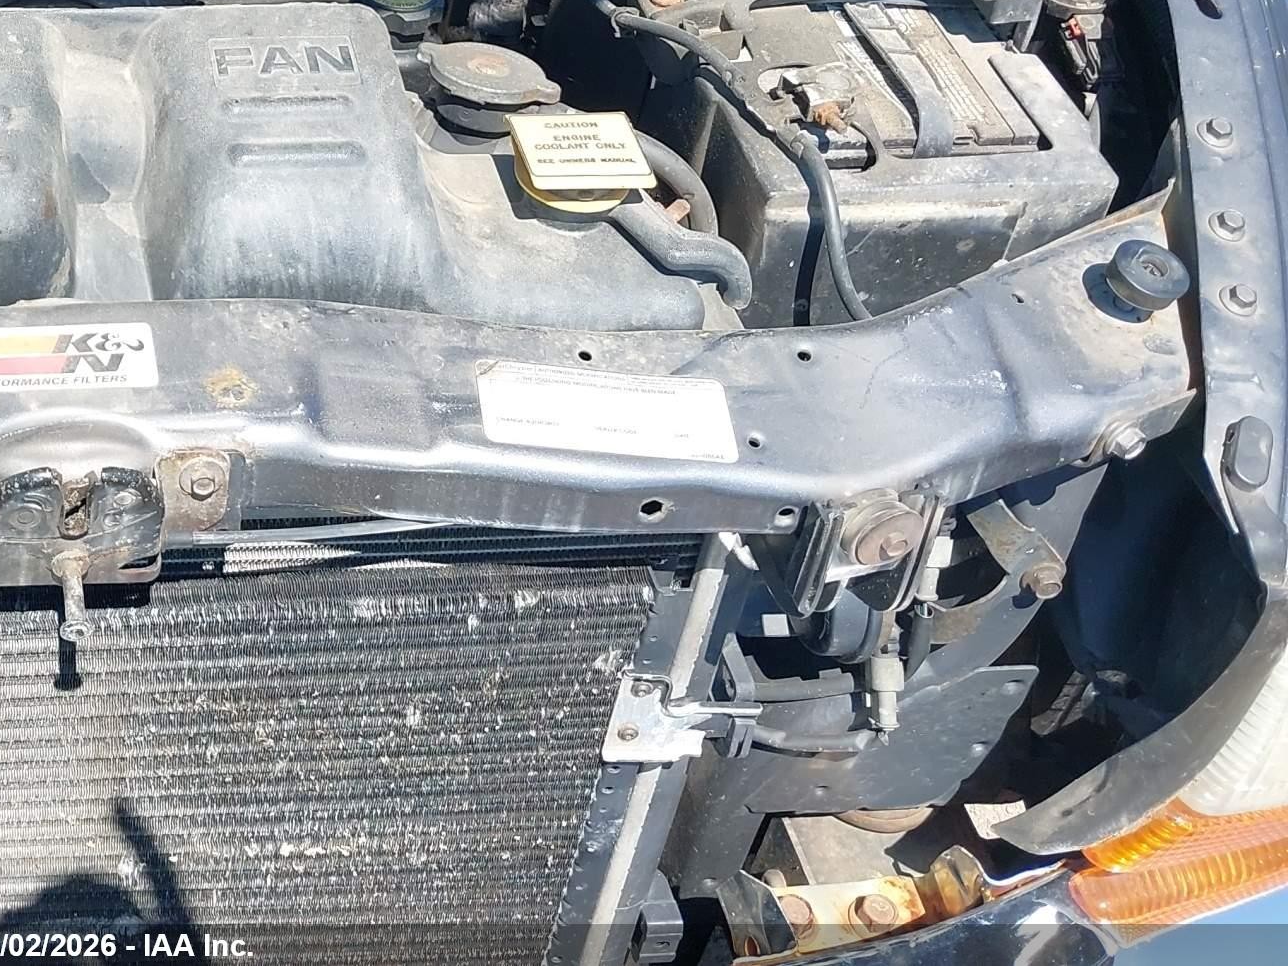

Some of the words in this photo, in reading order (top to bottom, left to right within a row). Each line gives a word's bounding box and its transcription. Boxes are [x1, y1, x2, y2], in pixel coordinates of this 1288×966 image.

[213, 45, 355, 76] FAN
[544, 121, 599, 129] CAUTION
[553, 134, 601, 142] ENGINE
[534, 143, 590, 151] COOLANT
[595, 142, 627, 150] ONLY
[51, 332, 145, 374] K&N
[73, 374, 128, 384] FILTERS
